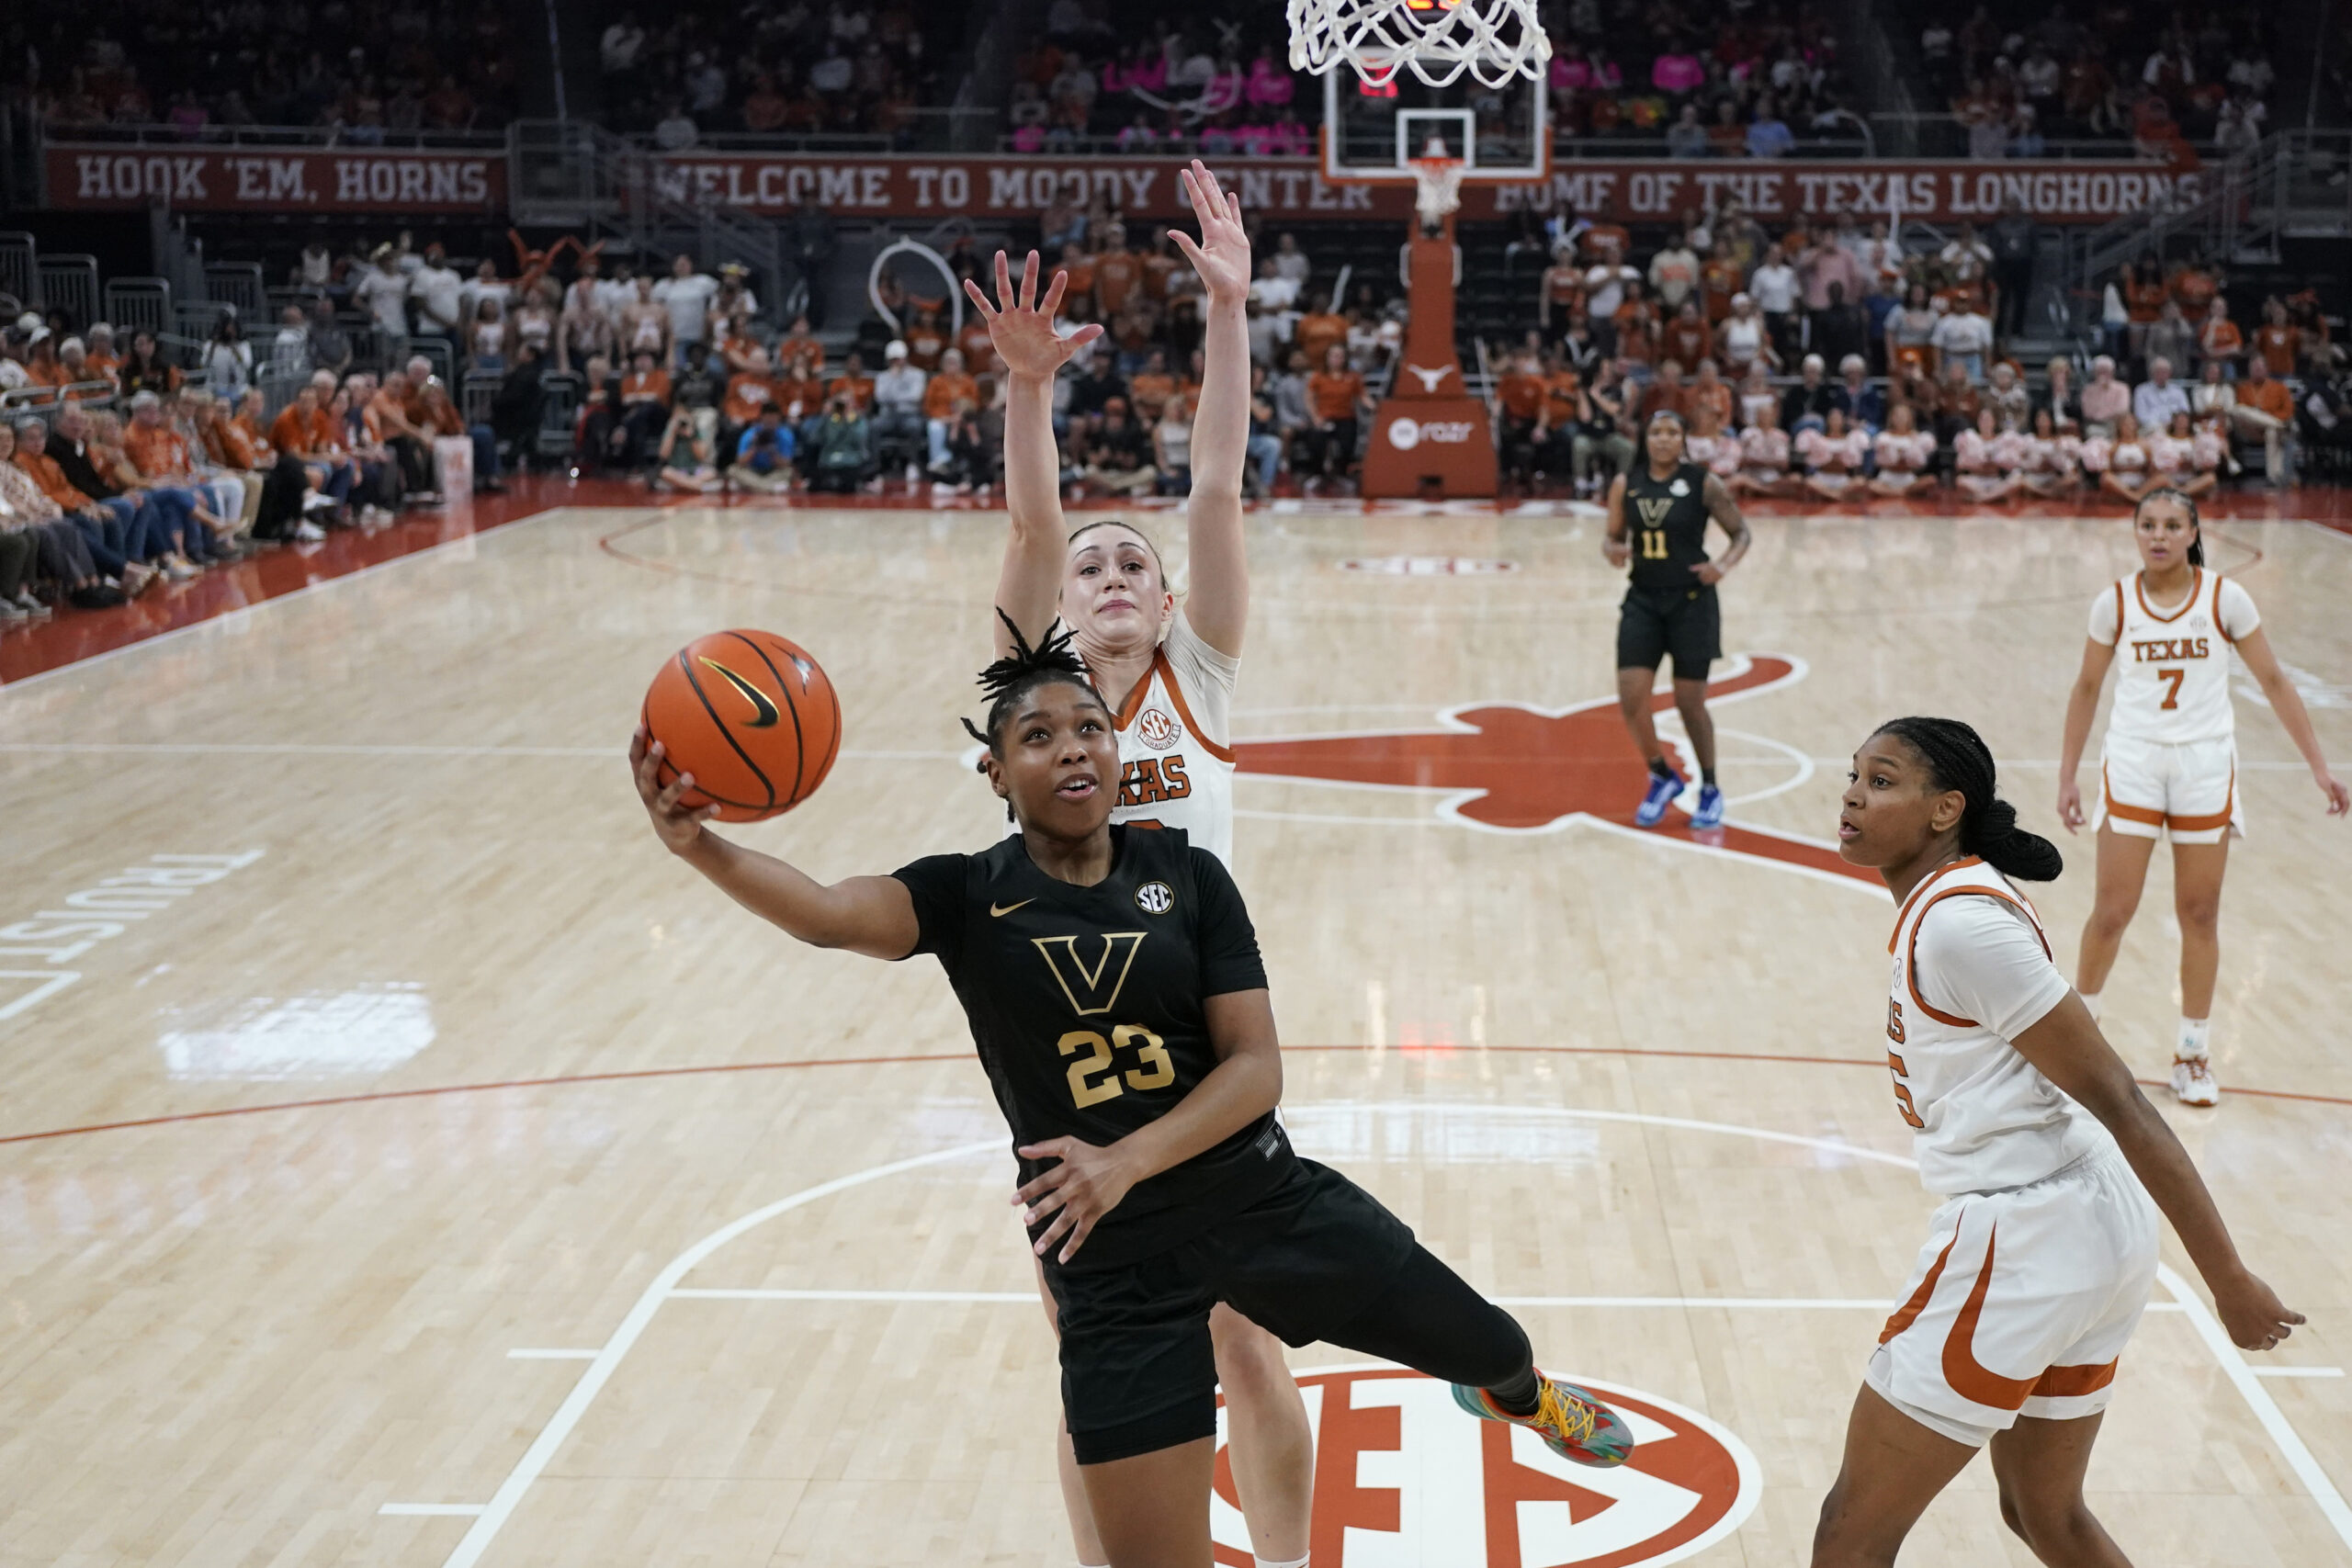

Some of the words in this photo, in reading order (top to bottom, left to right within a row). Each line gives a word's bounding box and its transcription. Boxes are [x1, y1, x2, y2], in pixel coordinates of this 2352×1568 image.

[76, 157, 207, 199] HOOK
[335, 161, 487, 203] HORNS
[653, 165, 891, 207] WELCOME
[907, 167, 969, 208] TO
[988, 168, 1158, 209] MOODY
[1628, 172, 1684, 212] OF
[1695, 173, 1784, 213] THE
[1795, 173, 1937, 213] TEXAS
[1949, 173, 2203, 213] LONGHORNS
[1642, 530, 1668, 559] 11
[2131, 638, 2210, 662] TEXAS
[2157, 669, 2185, 710] 7
[1141, 710, 1170, 739] SEC
[1114, 754, 1192, 807] XAS
[1136, 883, 1171, 912] SEC
[1030, 931, 1148, 1016] V
[1057, 1022, 1175, 1110] 23
